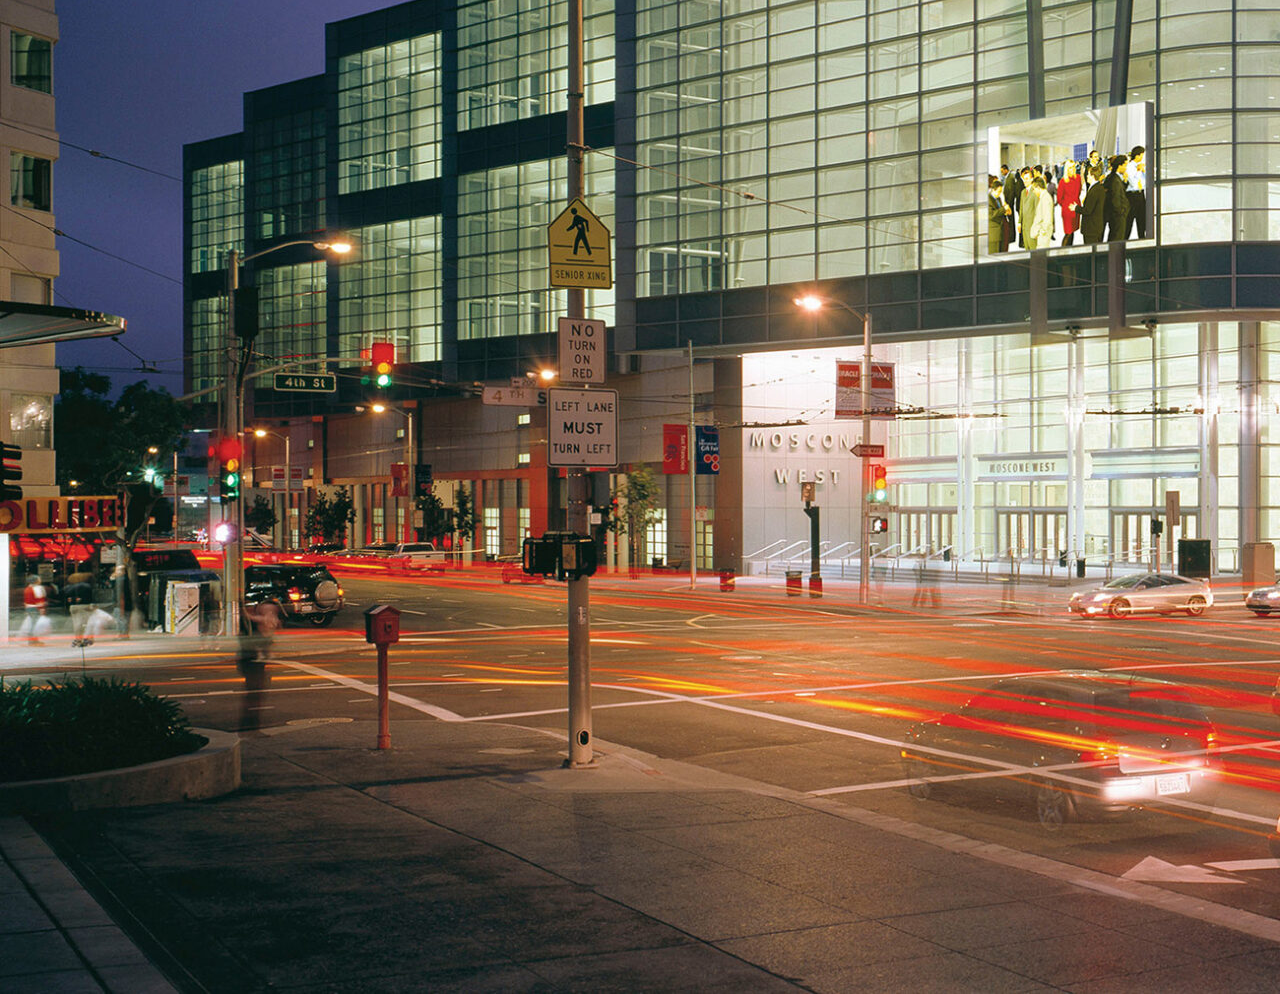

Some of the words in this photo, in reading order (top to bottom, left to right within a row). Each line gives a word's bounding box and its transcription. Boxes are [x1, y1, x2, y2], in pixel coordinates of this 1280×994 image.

[555, 270, 584, 280] SENIOR
[587, 272, 606, 281] XING
[571, 324, 594, 337] NO
[568, 340, 596, 351] TURN
[574, 354, 590, 364] ON
[572, 369, 593, 379] RED
[285, 377, 306, 387] 4th
[313, 378, 325, 388] St
[537, 391, 547, 405] S
[555, 401, 580, 412] LEFT
[587, 403, 614, 413] LANE
[563, 422, 603, 435] MUST
[553, 443, 580, 454] TURN
[587, 444, 612, 454] LEFT
[990, 462, 1030, 473] MOSCONE
[1032, 461, 1056, 472] WEST
[774, 468, 841, 485] WEST
[0, 499, 122, 532] OLLIBEE
